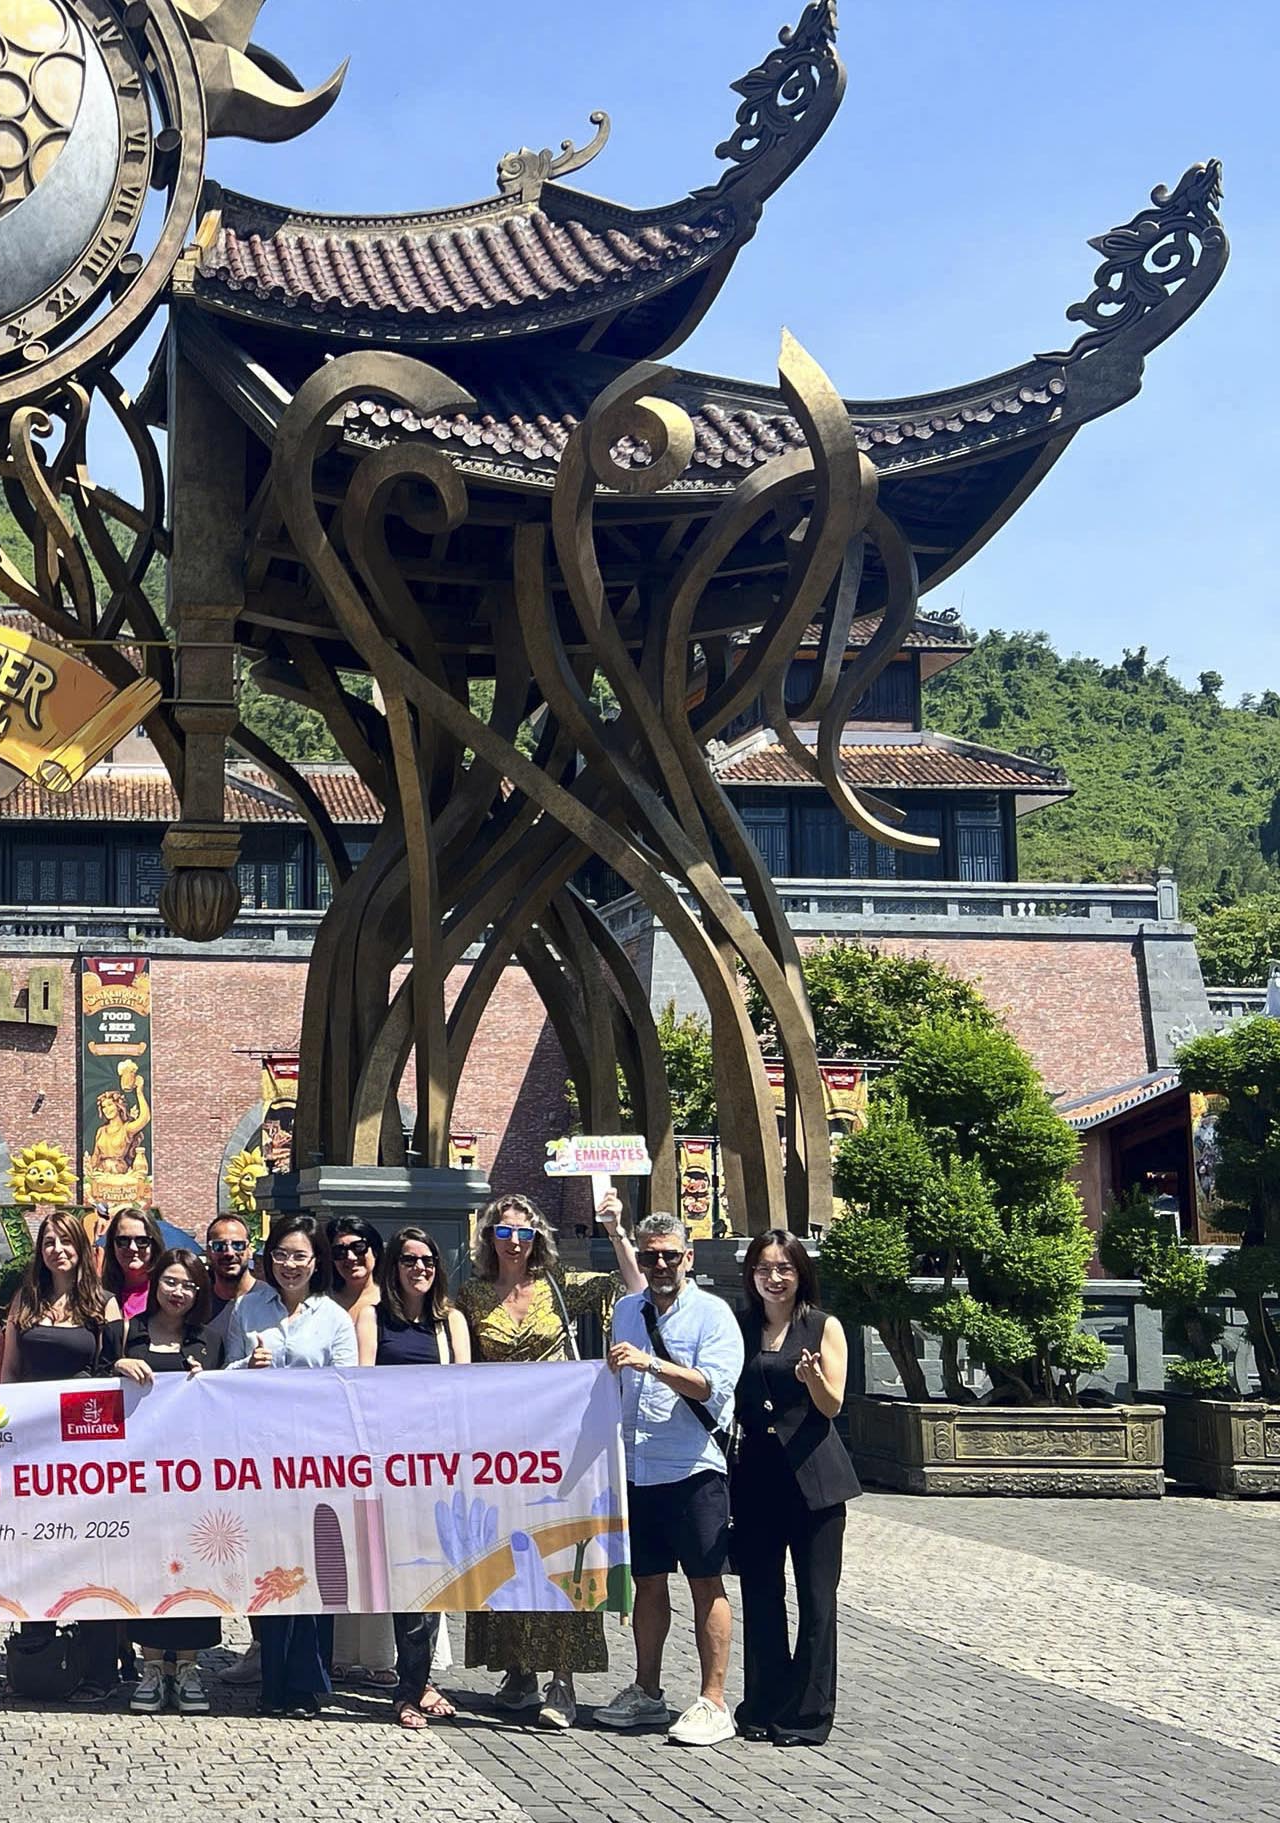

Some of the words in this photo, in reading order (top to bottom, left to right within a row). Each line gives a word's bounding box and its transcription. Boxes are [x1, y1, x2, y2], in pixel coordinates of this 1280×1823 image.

[102, 1012, 131, 1020] FOOD
[98, 1023, 107, 1031] &
[108, 1023, 136, 1031] BEER
[104, 1034, 131, 1042] FEST
[576, 1137, 641, 1148] WELCOME
[575, 1149, 644, 1161] EMIRATES
[67, 1422, 120, 1435] Emirates
[13, 1460, 147, 1498] EUROPE
[156, 1459, 203, 1493] TO
[214, 1457, 263, 1491] DA
[273, 1454, 373, 1489] NANG
[384, 1452, 461, 1487] CITY
[471, 1450, 563, 1486] 2025
[33, 1522, 79, 1542] 23th,
[84, 1520, 131, 1540] 2025
